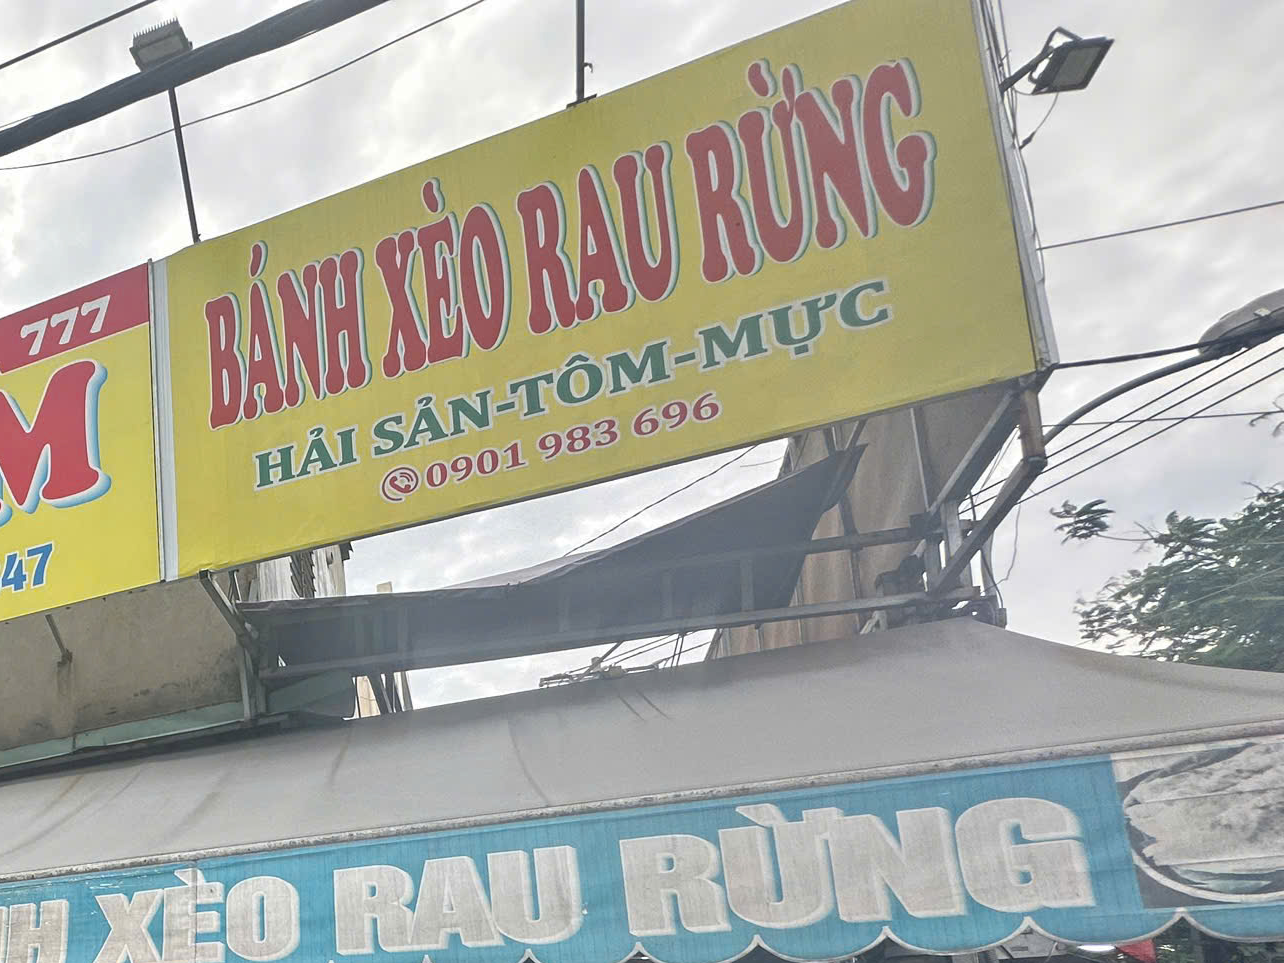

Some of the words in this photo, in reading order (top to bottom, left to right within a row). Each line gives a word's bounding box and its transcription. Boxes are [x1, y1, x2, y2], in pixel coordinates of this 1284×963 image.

[204, 240, 372, 430] BÁNH
[376, 178, 511, 378] XÈO
[517, 140, 673, 338] RAU
[685, 58, 937, 283] RỪNG
[20, 294, 111, 356] 777
[255, 426, 356, 488] HẢI
[373, 280, 891, 457] SẢN-TÔM-MỰC
[426, 442, 527, 488] 0901
[537, 418, 619, 461] 983
[633, 392, 721, 438] 696
[333, 845, 584, 955] RAU
[619, 797, 1096, 937] RỪNG
